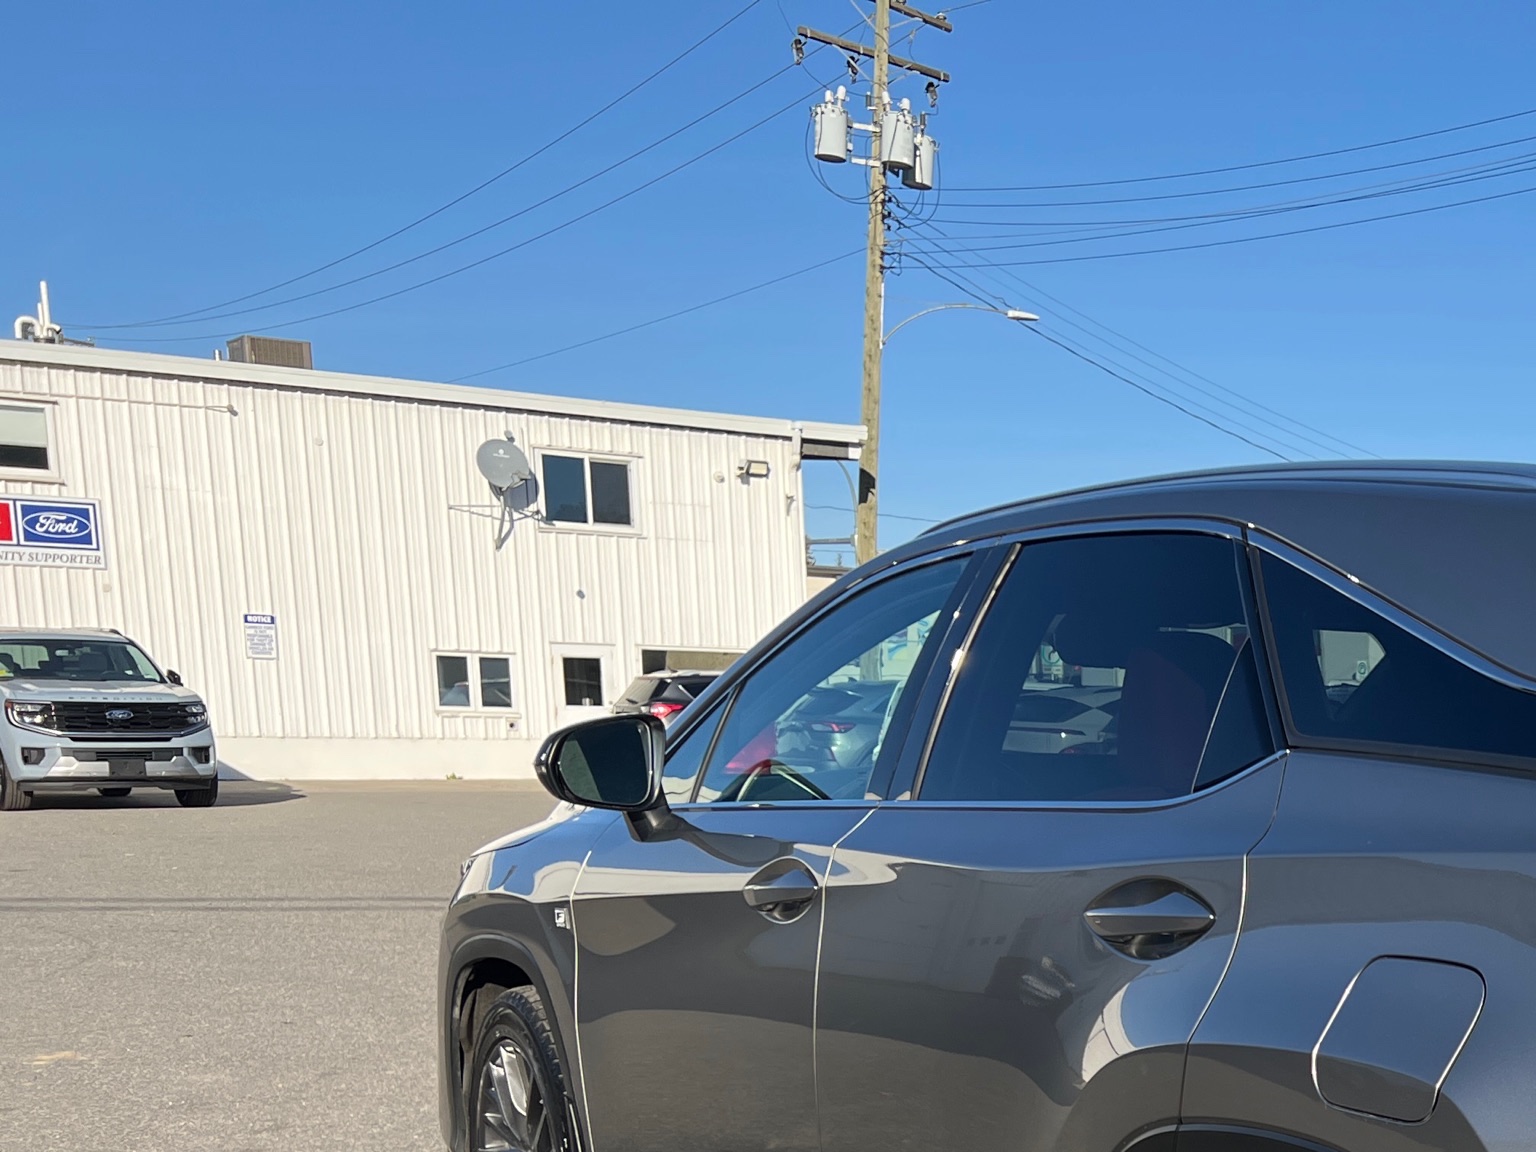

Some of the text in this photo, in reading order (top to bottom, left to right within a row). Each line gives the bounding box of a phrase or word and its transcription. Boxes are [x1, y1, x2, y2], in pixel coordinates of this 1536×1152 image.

[35, 514, 79, 534] Ford
[27, 552, 102, 565] SUPPORTER
[246, 615, 272, 624] NOTICE
